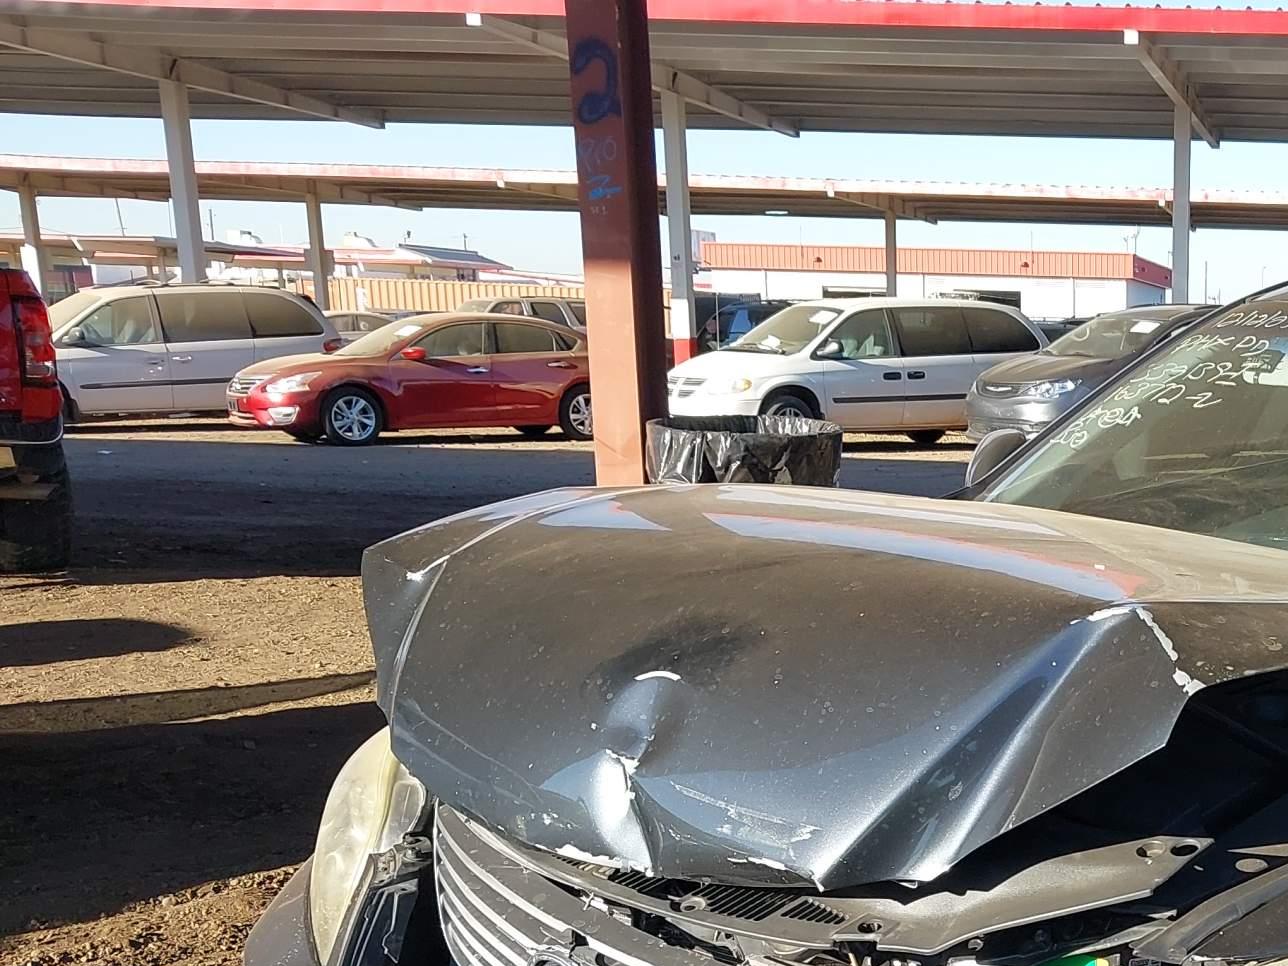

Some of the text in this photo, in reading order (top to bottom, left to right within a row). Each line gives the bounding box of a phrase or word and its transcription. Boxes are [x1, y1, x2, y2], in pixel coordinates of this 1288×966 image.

[571, 36, 623, 125] 2
[1171, 334, 1235, 354] PHX
[1232, 335, 1270, 357] PD
